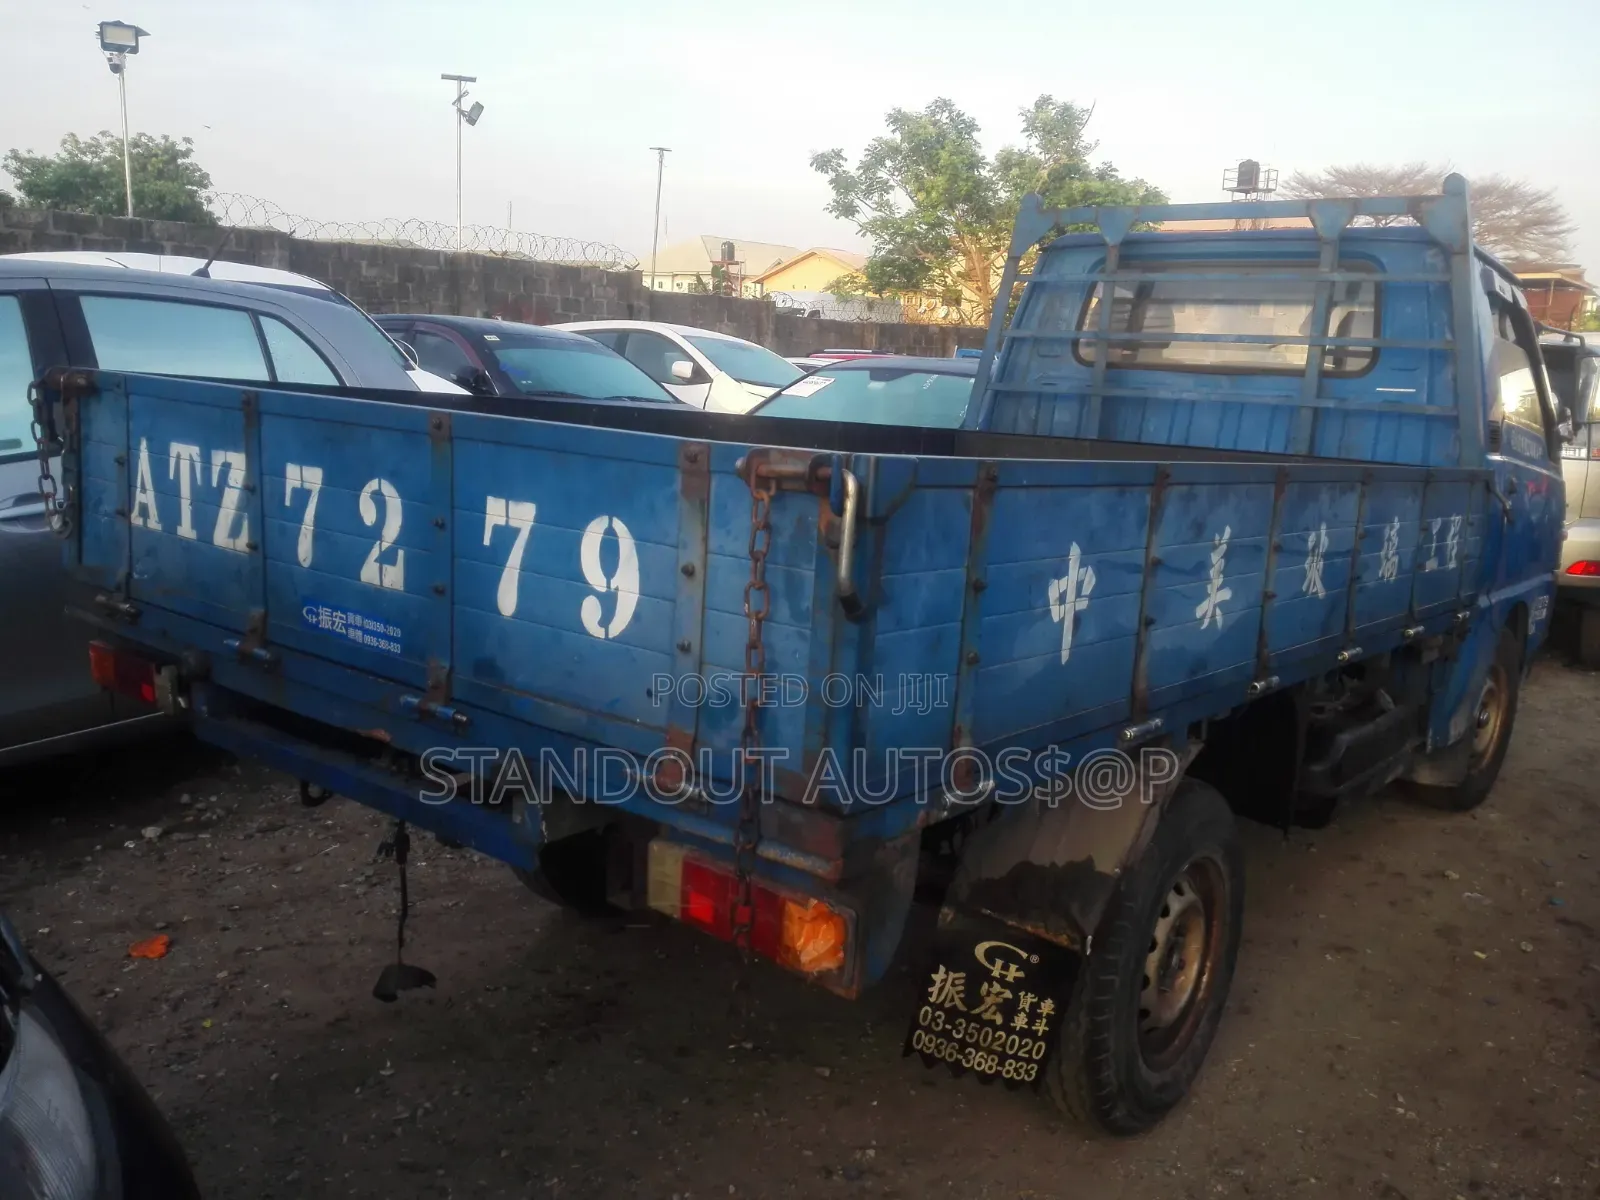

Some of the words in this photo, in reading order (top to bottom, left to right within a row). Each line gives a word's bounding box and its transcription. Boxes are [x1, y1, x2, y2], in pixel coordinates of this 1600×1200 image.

[928, 964, 1013, 1026] 振宏
[912, 1029, 1039, 1082] 0936-368-833
[919, 1005, 1047, 1061] 03-3502020
